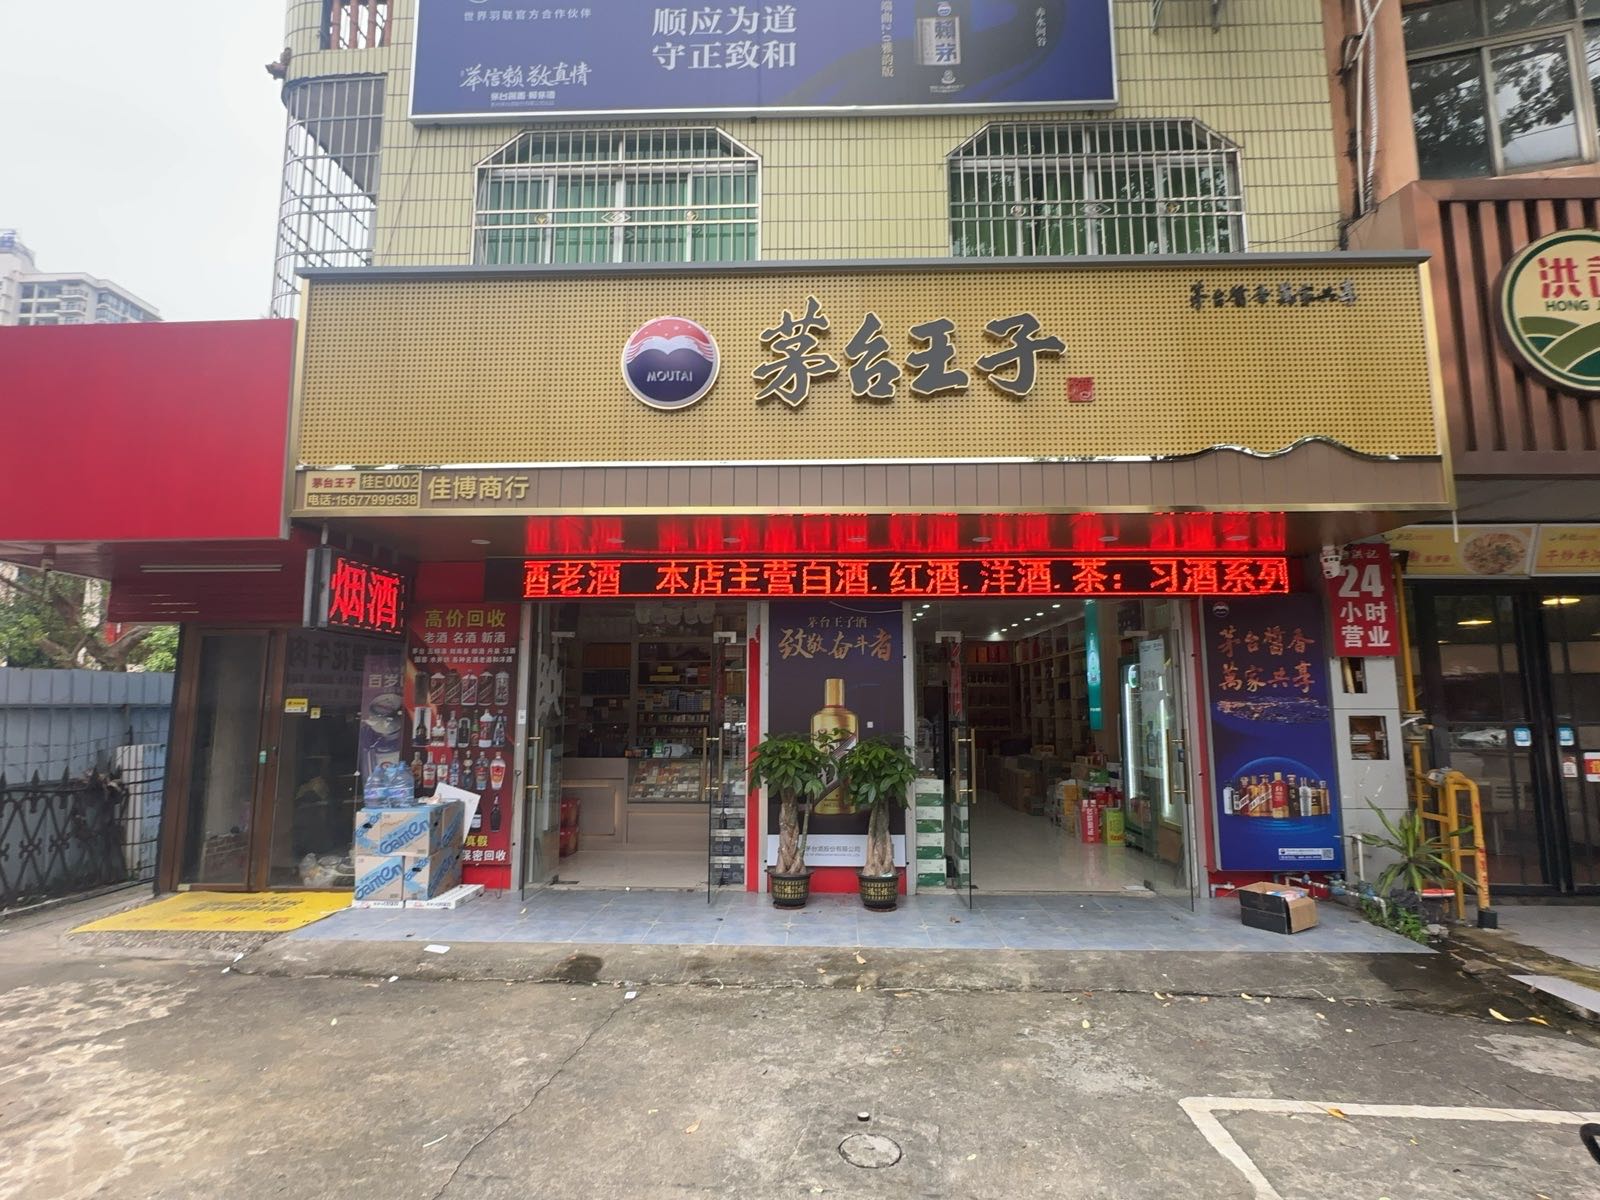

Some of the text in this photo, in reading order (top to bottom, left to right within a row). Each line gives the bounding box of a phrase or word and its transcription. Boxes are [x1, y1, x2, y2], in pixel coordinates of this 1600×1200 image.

[464, 8, 592, 22] 世界羽联官方合作伙伴
[652, 5, 797, 36] 顺应为道
[652, 40, 796, 70] 守正致和
[1545, 301, 1589, 312] HONG
[753, 295, 1067, 408] 茅台王子
[646, 370, 693, 383] MOUTAI
[311, 477, 356, 489] 茅台王子
[427, 475, 529, 500] 佳博商行
[1338, 564, 1384, 597] 24
[329, 557, 399, 629] 烟酒
[424, 609, 506, 628] 高价回收
[1340, 602, 1387, 624] 小时
[424, 631, 506, 643] 老酒 名酒 新酒
[778, 627, 893, 661] 致敬奋斗者
[1341, 625, 1391, 648] 营业
[369, 673, 404, 690] 百岁
